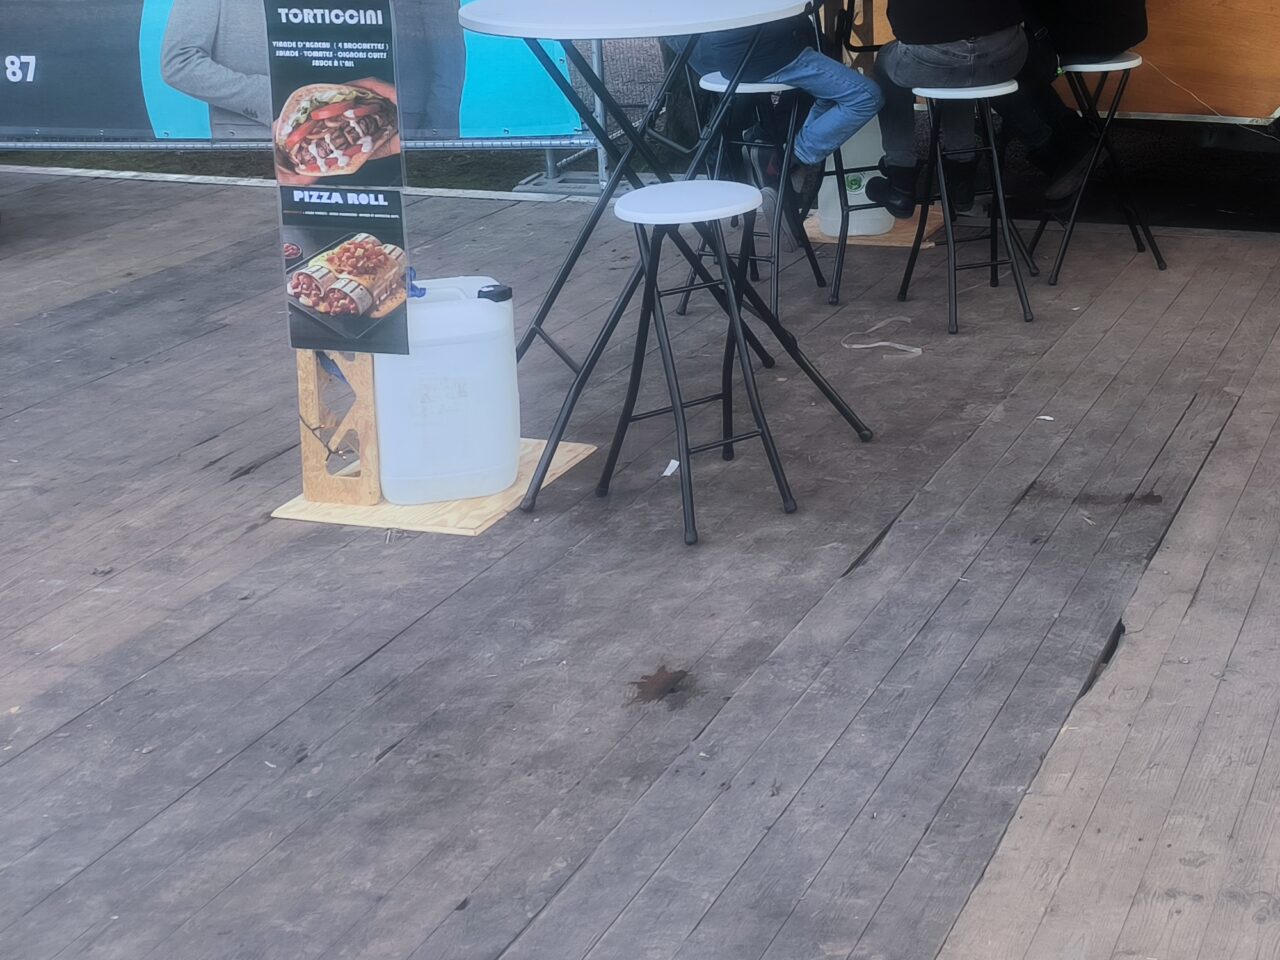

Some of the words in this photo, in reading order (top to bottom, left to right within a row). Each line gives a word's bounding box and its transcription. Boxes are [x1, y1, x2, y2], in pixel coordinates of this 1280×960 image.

[278, 8, 383, 24] TORTICCINI
[5, 55, 36, 82] 87
[293, 190, 343, 204] PIZZA
[347, 193, 388, 206] ROLL
